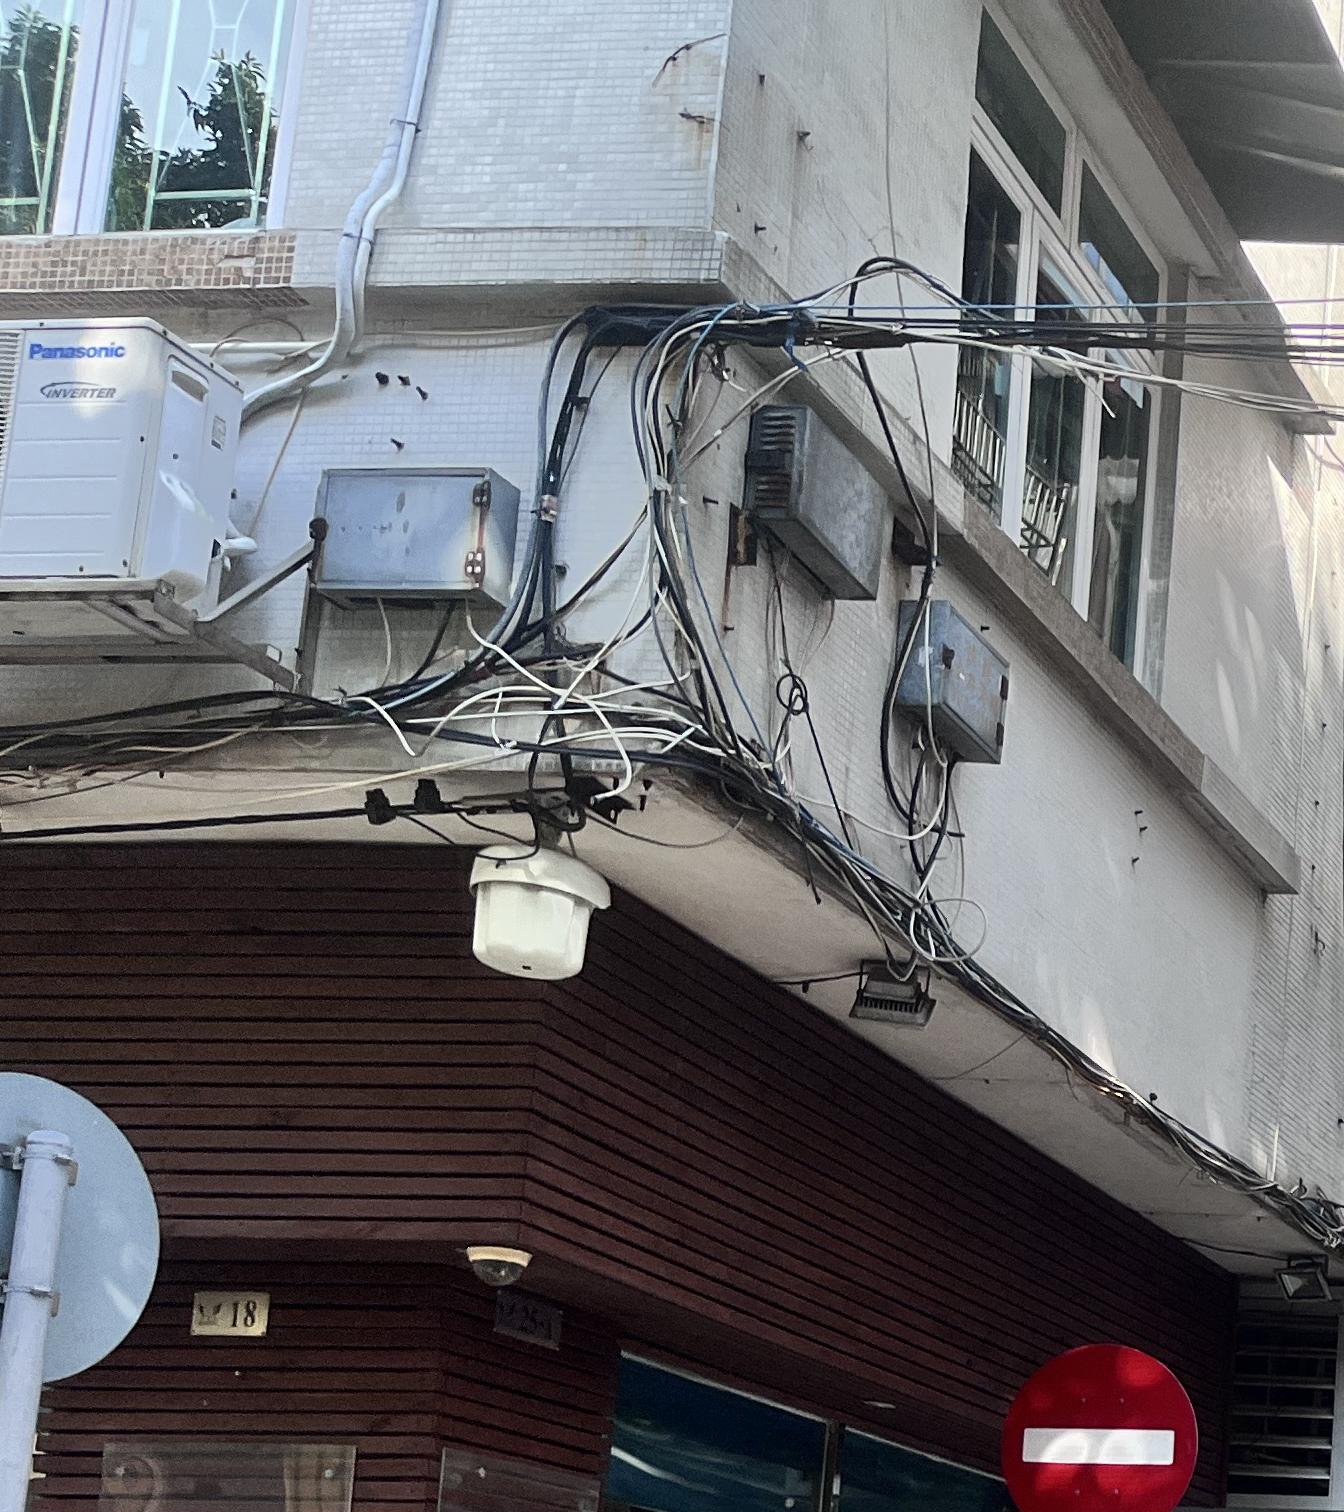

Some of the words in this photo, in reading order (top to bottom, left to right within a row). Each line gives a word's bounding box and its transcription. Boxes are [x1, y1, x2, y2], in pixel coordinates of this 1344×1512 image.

[29, 342, 125, 359] Panasonic
[46, 387, 117, 399] INVERTER
[230, 1300, 258, 1328] 18
